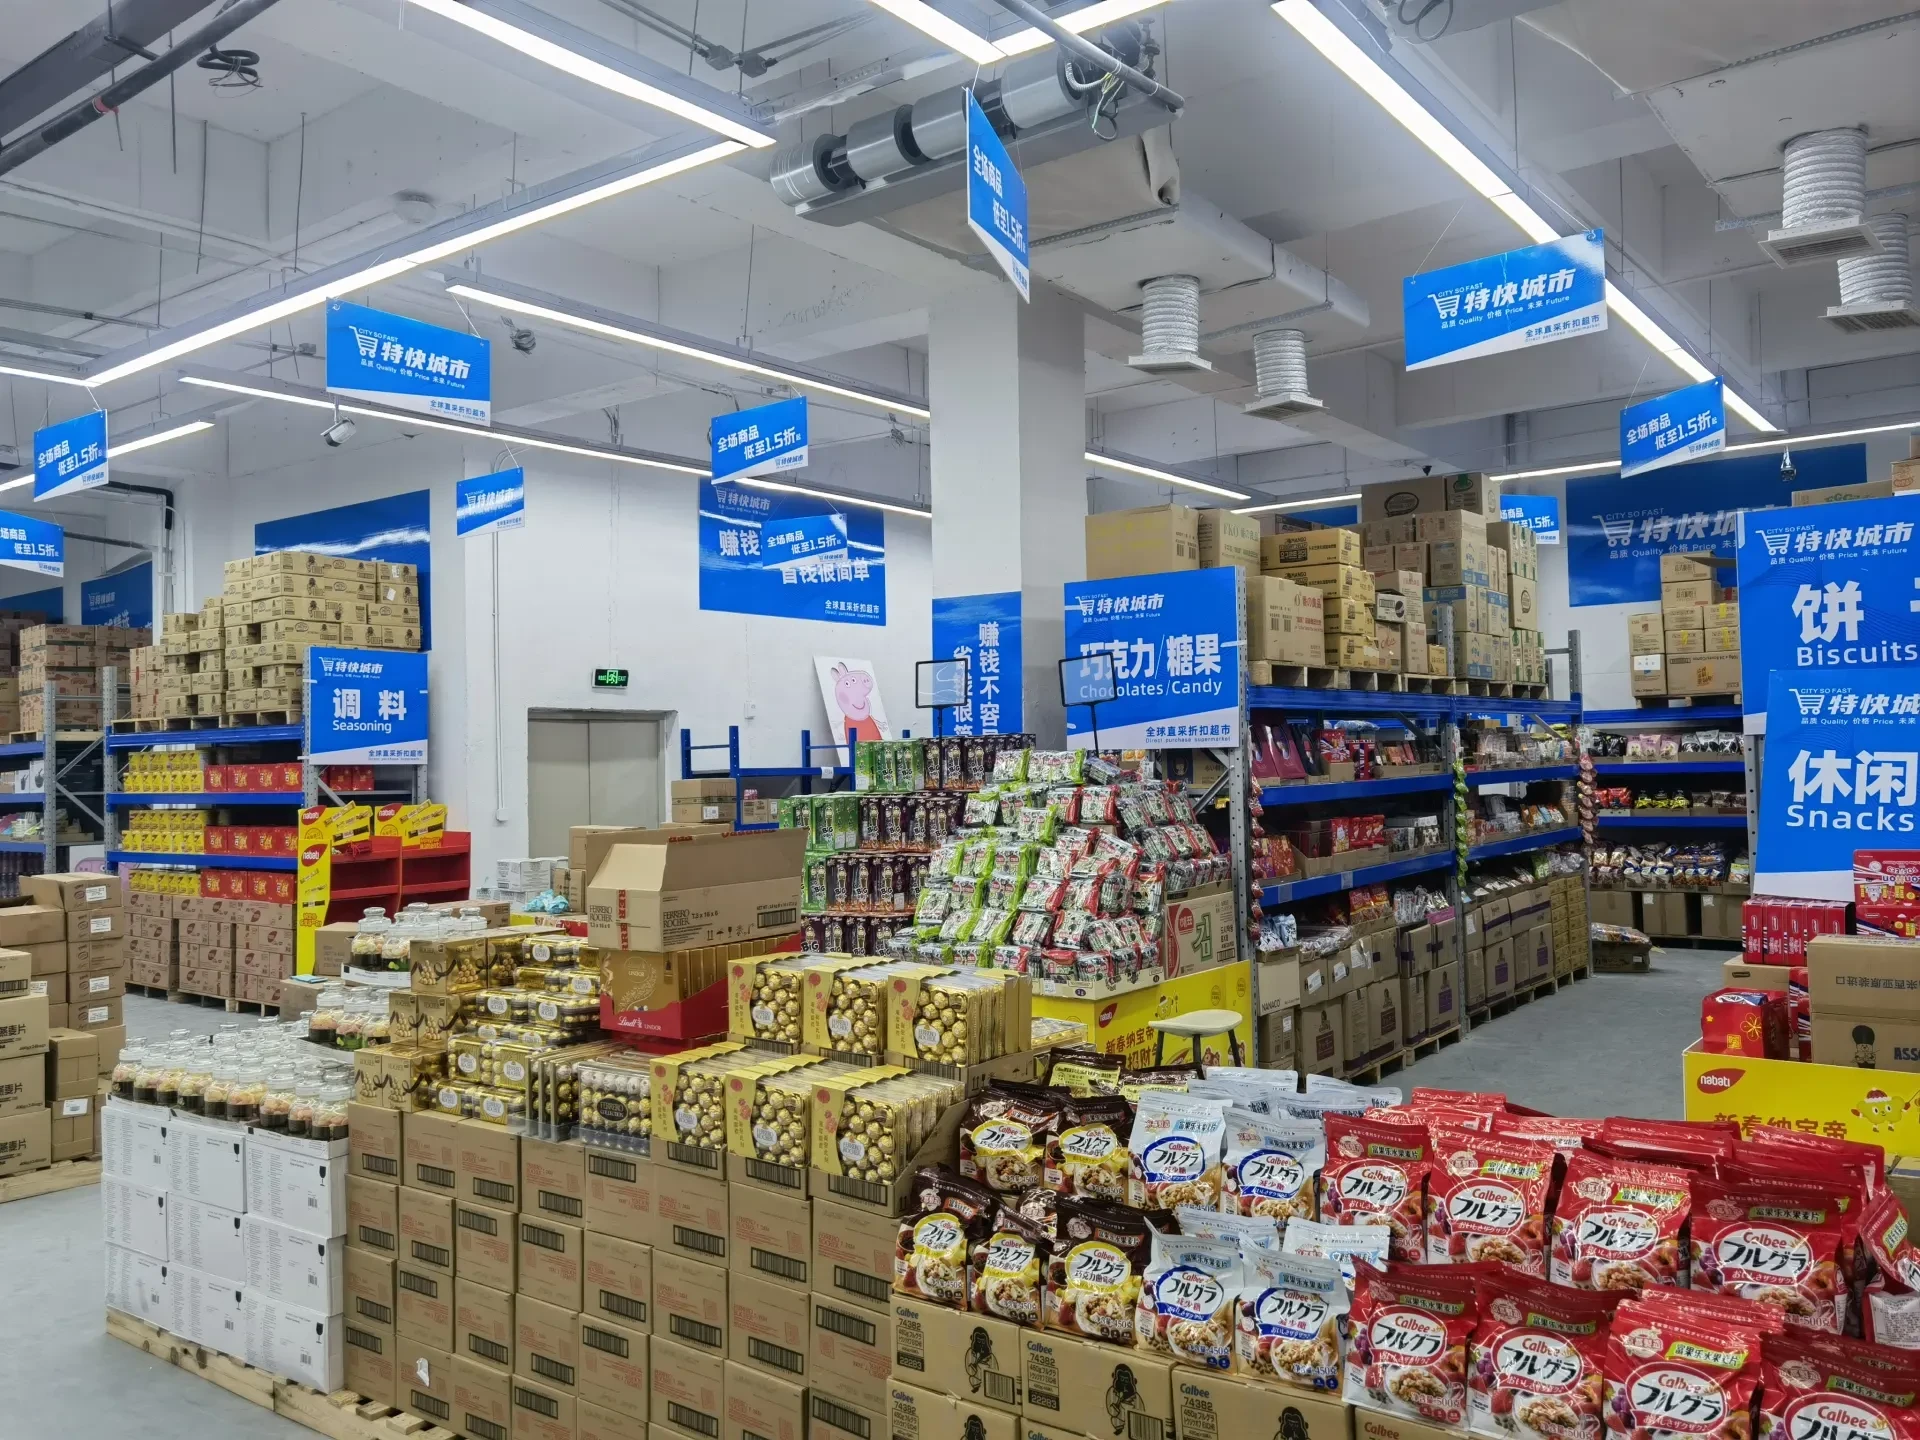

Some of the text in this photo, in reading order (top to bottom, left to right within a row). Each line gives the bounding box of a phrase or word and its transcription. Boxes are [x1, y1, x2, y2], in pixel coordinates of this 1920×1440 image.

[973, 144, 1003, 198] 全场商品
[1438, 282, 1484, 298] CITY SO FAST
[1463, 268, 1576, 314] 特快城市
[1458, 315, 1483, 326] Quality
[1505, 306, 1524, 316] Price
[1546, 295, 1570, 306] Future
[358, 327, 373, 336] CITY
[1525, 314, 1600, 338] 全球直采折扣超市
[381, 341, 471, 379] 特快城市
[430, 400, 486, 418] 全球直采折扣超市
[1626, 412, 1671, 445] 全场商品
[1655, 410, 1718, 451] 低至1.5折起
[717, 424, 760, 453] 全场商品
[743, 426, 801, 461] 低至1.5折起
[38, 440, 70, 468] 全场商品
[727, 492, 771, 511] 特快城市
[1606, 513, 1625, 521] CITY
[1641, 508, 1665, 517] FAST
[719, 529, 762, 556] 赚钱
[767, 530, 805, 548] 全场商品
[1794, 521, 1915, 553] 特快城市
[1610, 543, 1717, 559] 品质 Quality 价格 Price
[1770, 547, 1908, 565] 品质 Quality 价格 Price 未来 Future
[825, 599, 880, 614] 全球直采折扣超市
[1097, 593, 1164, 615] 特快城市
[1080, 634, 1221, 681] 巧克力/糖果
[1796, 640, 1918, 667] Biscuits
[335, 661, 383, 674] 特快城市
[332, 720, 392, 734] Seasoning
[1146, 724, 1231, 737] 全球直采折扣超市
[1820, 718, 1848, 726] Quality
[368, 749, 423, 757] 全球直采折扣超市
[1788, 749, 1919, 807] 休闲
[1786, 804, 1915, 832] Snacks
[589, 905, 613, 914] FERRERO
[589, 913, 613, 922] ROCHER
[663, 909, 690, 920] FERRERO
[663, 918, 690, 928] ROCHER
[1836, 975, 1920, 991] 来西亚原装进口
[1700, 1074, 1731, 1088] nabati
[1168, 1142, 1190, 1152] Calbee
[1371, 1145, 1418, 1160] 富果乐水果麦片
[1153, 1149, 1200, 1167] フルグラ
[1266, 1156, 1290, 1166] Calbee
[1250, 1160, 1300, 1185] フルグラ
[1361, 1168, 1394, 1183] Calbee
[1344, 1176, 1405, 1202] フルグラ
[1472, 1188, 1508, 1203] Calbee
[1452, 1196, 1522, 1226] フルグラ
[1755, 1208, 1820, 1222] 富果乐水果麦片
[1601, 1213, 1640, 1231] Calbee
[1584, 1219, 1657, 1250] フルグラ
[1743, 1231, 1787, 1248] Calbee
[1001, 1239, 1022, 1249] Calbee
[989, 1246, 1032, 1265] フルグラ
[1094, 1249, 1116, 1261] Calbee
[1723, 1240, 1807, 1273] フルグラ
[1077, 1253, 1125, 1278] フルグラ
[1182, 1272, 1205, 1284] Calbee
[1166, 1278, 1219, 1303] フルグラ
[1283, 1290, 1308, 1302] Calbee
[896, 1306, 919, 1319] Calbee
[1268, 1296, 1325, 1322] フルグラ
[1404, 1296, 1460, 1314] 富果乐水果麦片
[899, 1318, 921, 1330] 74382
[1395, 1315, 1431, 1334] Calbee
[1532, 1315, 1592, 1333] 富果乐水果麦片
[1027, 1340, 1053, 1353] Calbee
[1374, 1323, 1441, 1354] フルグラ
[1522, 1338, 1561, 1357] Calbee
[1029, 1353, 1056, 1367] 74382
[1503, 1346, 1578, 1384] フルグラ
[1180, 1383, 1210, 1398] Calbee
[1657, 1373, 1702, 1394] Calbee
[891, 1389, 915, 1404] Calbee
[1183, 1396, 1213, 1411] 74382
[1637, 1383, 1722, 1421] フルグラ
[894, 1401, 917, 1414] 74382
[1817, 1405, 1868, 1430] Calbee
[1364, 1421, 1400, 1440] Calbee
